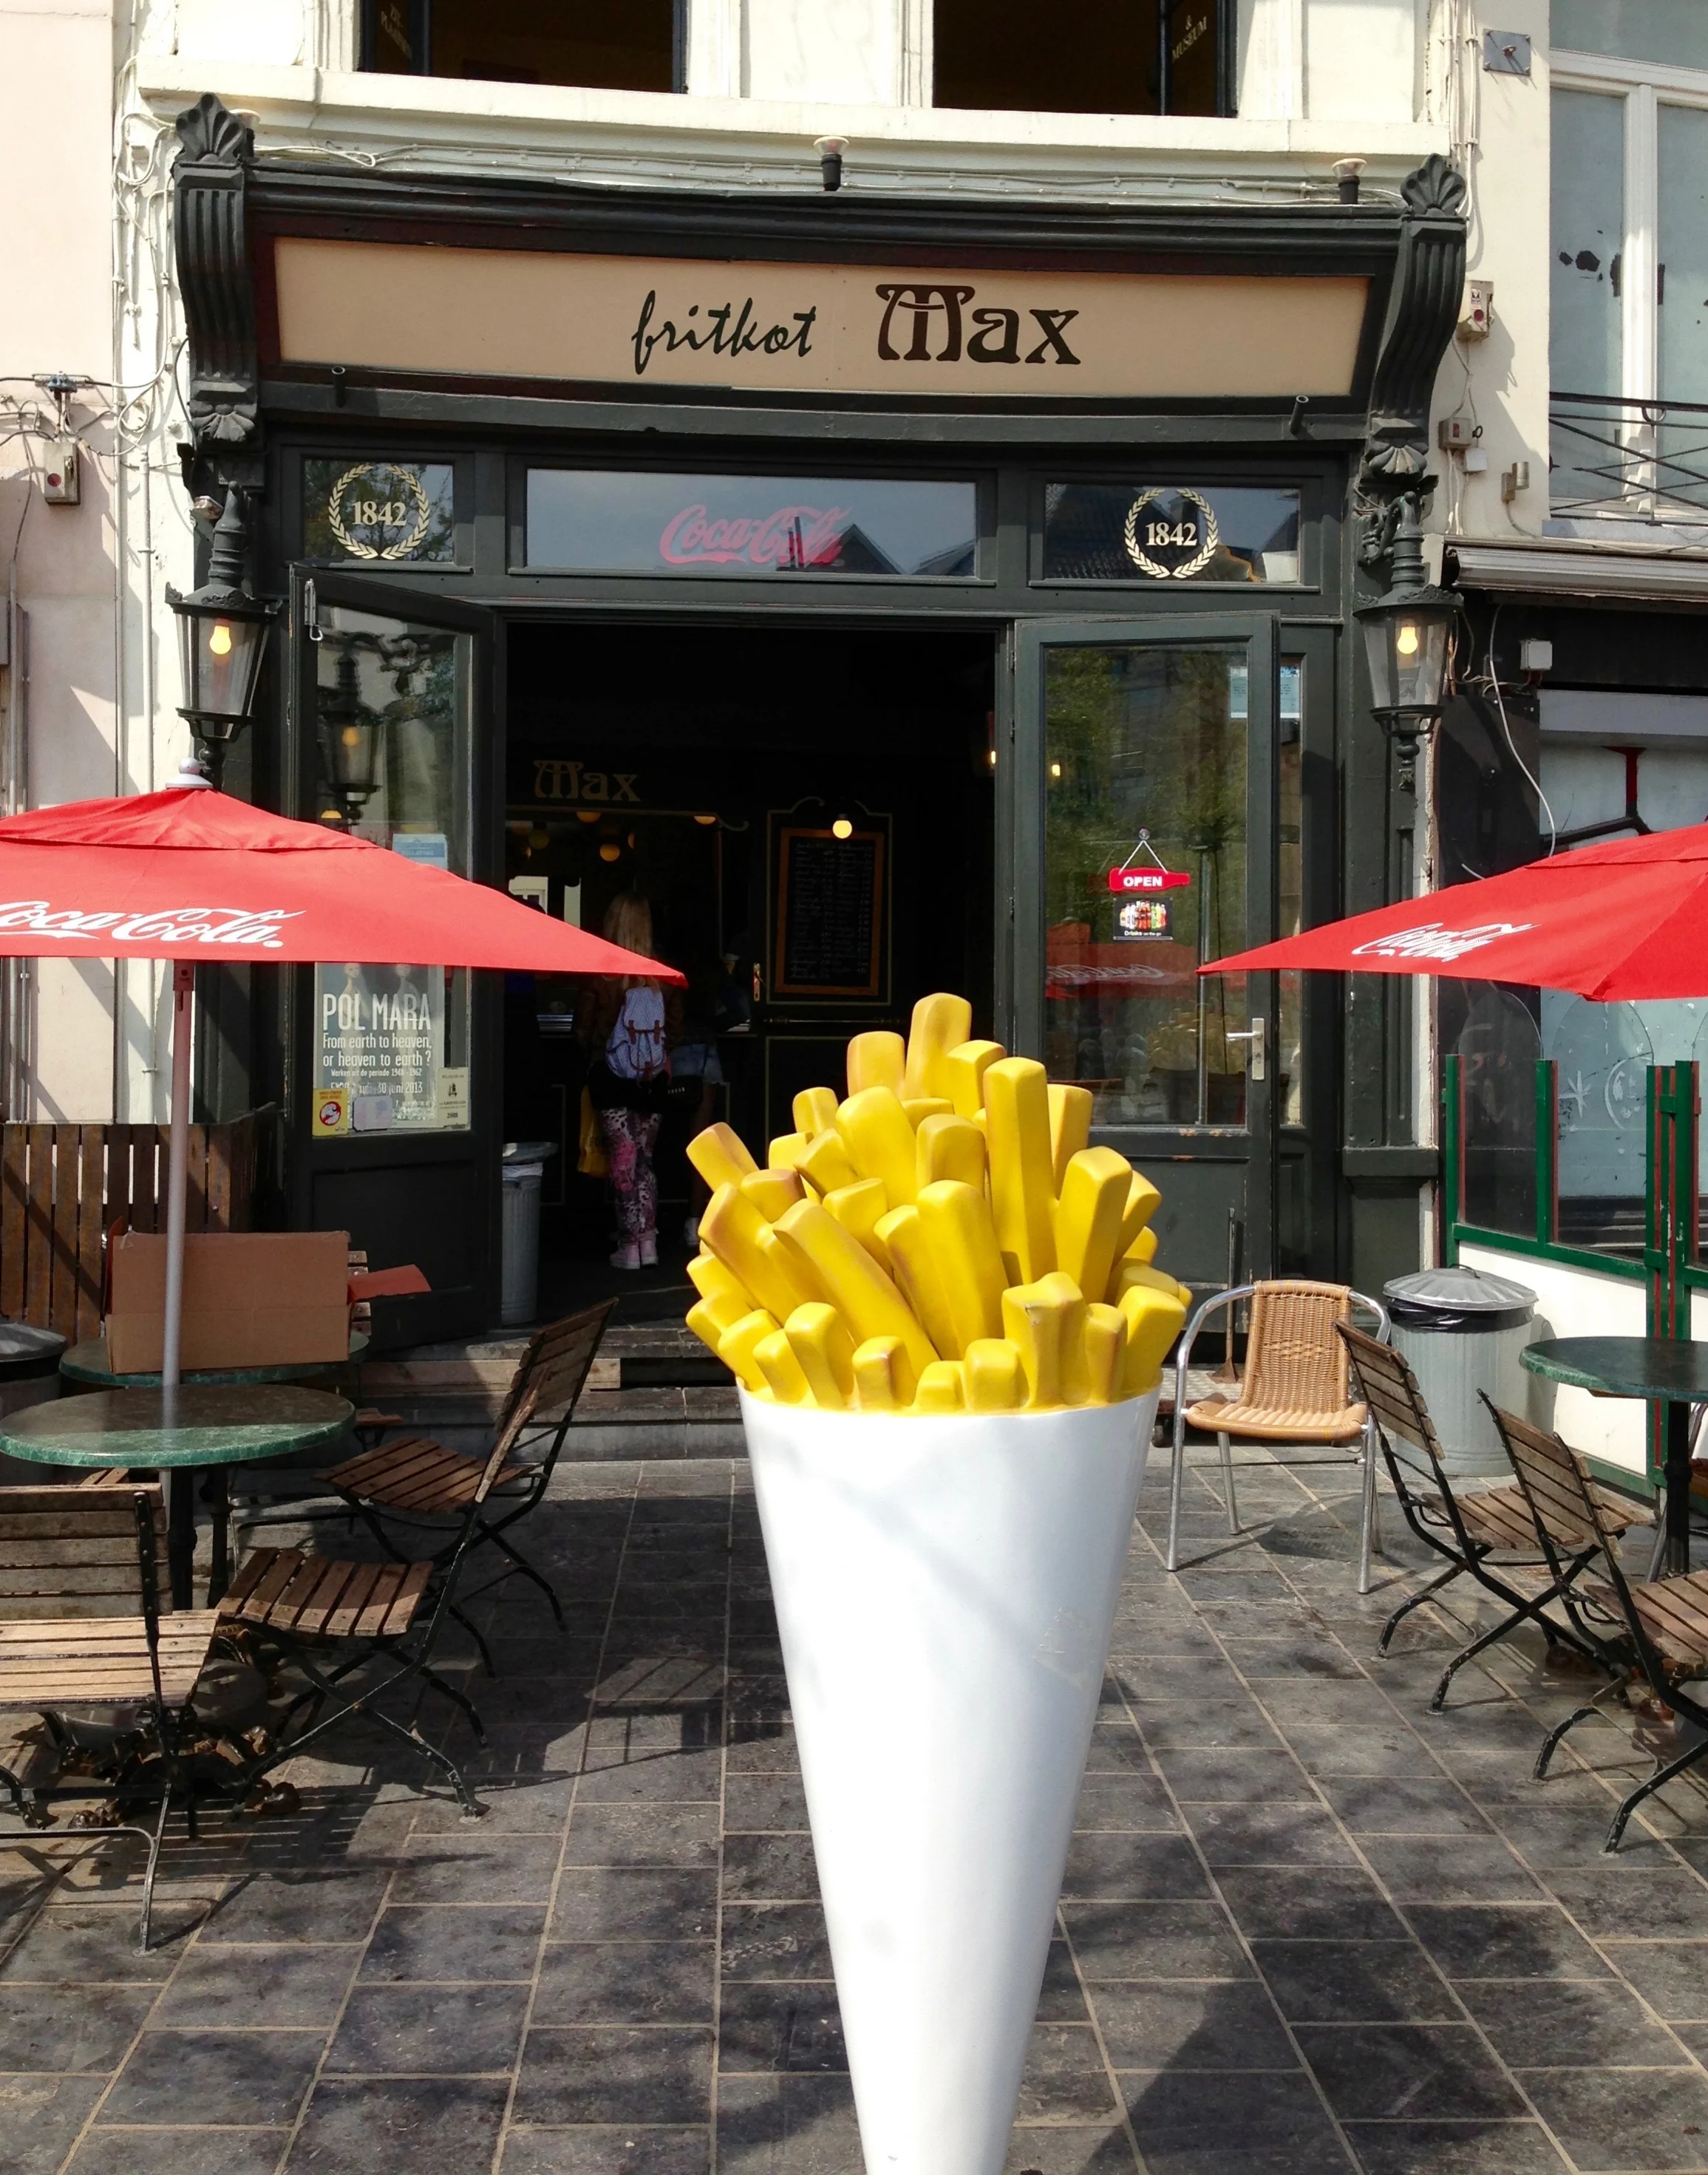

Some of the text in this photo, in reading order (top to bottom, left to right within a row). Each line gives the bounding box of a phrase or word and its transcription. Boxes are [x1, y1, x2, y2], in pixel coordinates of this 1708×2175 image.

[1172, 16, 1207, 64] MUSEUM
[631, 284, 1081, 375] fritkot Max
[352, 500, 407, 525] 1842
[1146, 522, 1197, 546] 1842
[533, 760, 642, 802] Max
[1123, 877, 1163, 887] OPEN
[322, 993, 432, 1031] POL MARA
[322, 1032, 432, 1049] From earth to heaven,
[322, 1055, 333, 1067] or
[338, 1050, 375, 1067] heaven
[380, 1053, 391, 1067] to
[330, 1069, 351, 1077] Werken
[388, 1082, 404, 1095] juni
[404, 1081, 423, 1094] 2013
